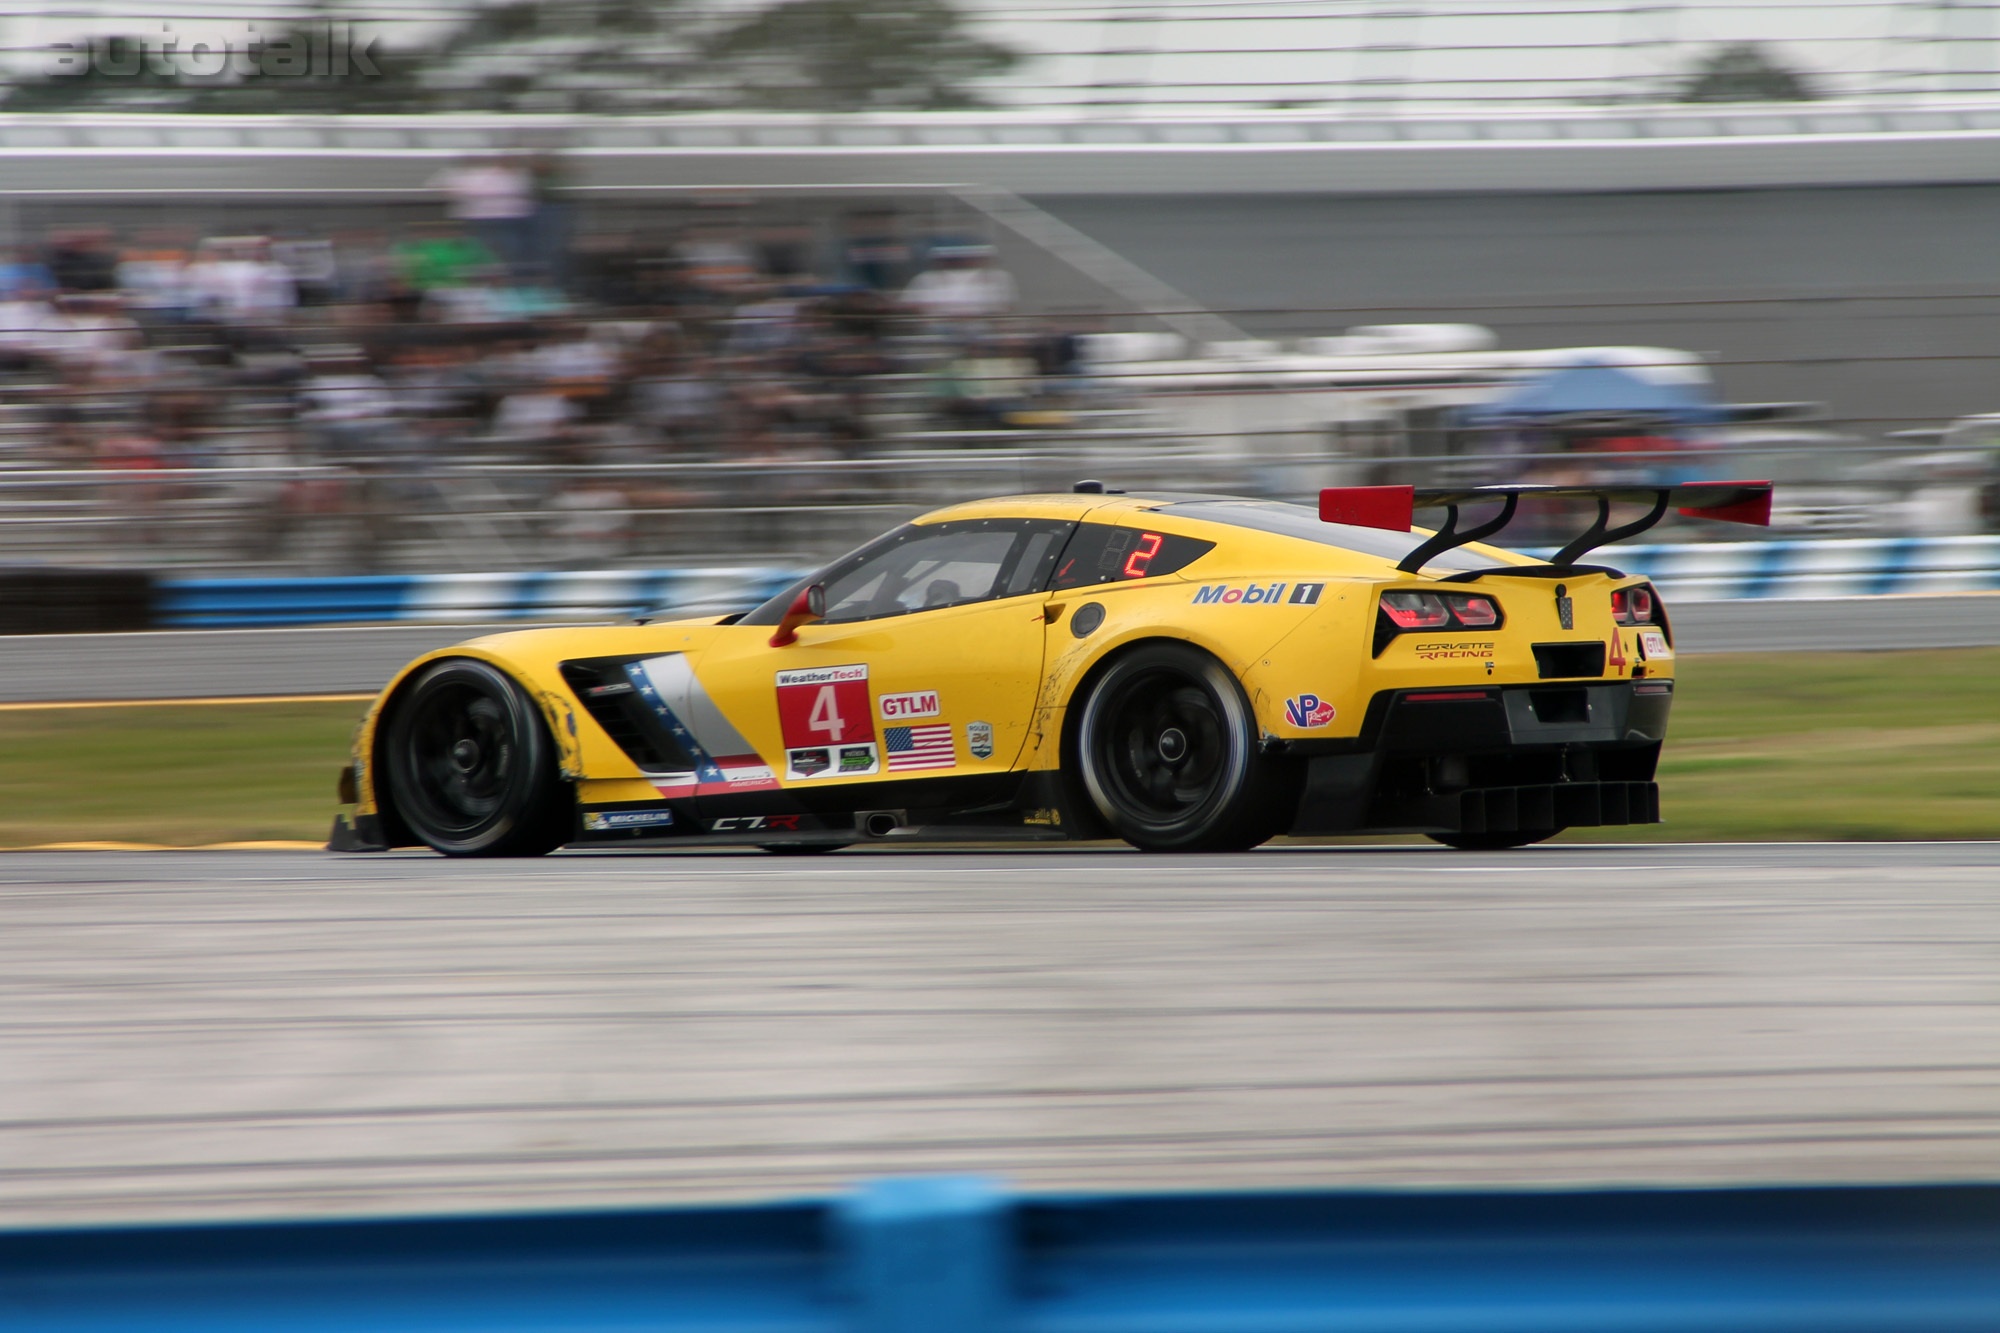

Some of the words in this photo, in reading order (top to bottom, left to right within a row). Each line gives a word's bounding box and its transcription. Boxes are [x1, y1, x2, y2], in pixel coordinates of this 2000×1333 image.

[1124, 532, 1163, 577] 2
[1192, 583, 1287, 604] Mobil
[1299, 584, 1314, 603] 1
[1416, 642, 1494, 651] CORVETTE
[1416, 651, 1493, 660] RACING
[1609, 627, 1626, 676] 4
[780, 668, 864, 684] WeatherTech
[808, 685, 845, 742] 4
[883, 695, 937, 716] GTLM
[1286, 694, 1319, 727] VP
[972, 733, 989, 743] 24
[609, 813, 668, 823] MICHELIN
